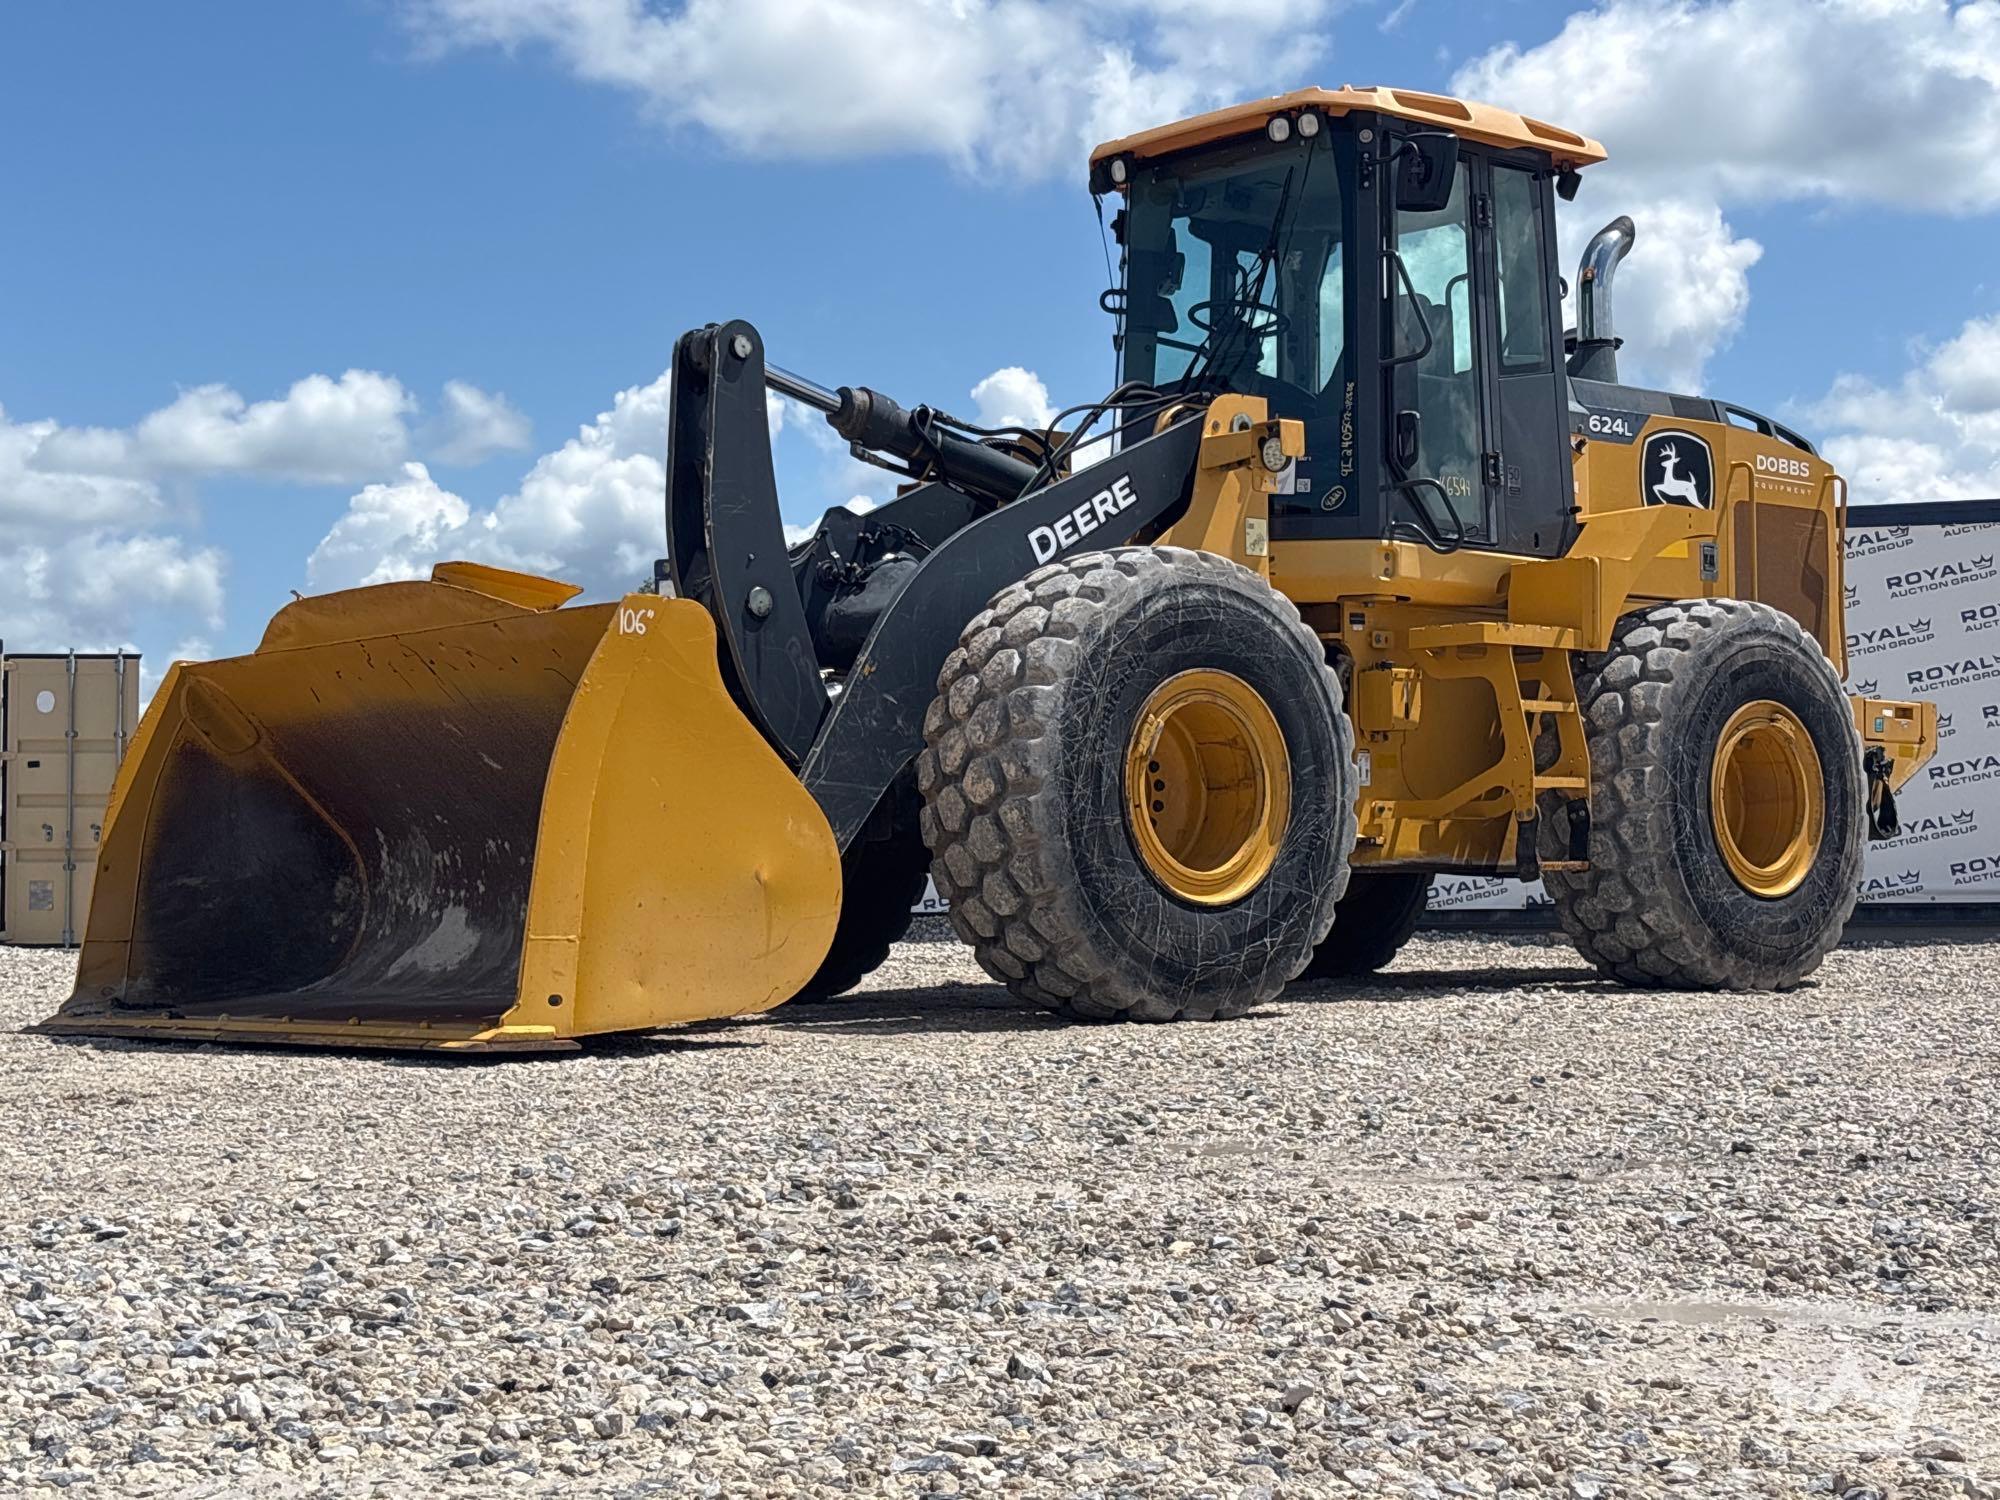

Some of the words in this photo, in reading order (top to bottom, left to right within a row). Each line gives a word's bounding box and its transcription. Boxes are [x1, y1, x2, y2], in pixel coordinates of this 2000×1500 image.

[1588, 414, 1633, 437] 624L
[1756, 454, 1810, 477] DOBBS
[1753, 481, 1812, 495] EQUIPMENT
[1026, 474, 1138, 566] DEERE
[1867, 538, 1914, 554] GROUP
[1885, 561, 1973, 590] ROYAL
[1890, 580, 1949, 600] AUCTION
[1951, 569, 1998, 586] GROUP
[619, 607, 655, 635] 106"
[1888, 633, 1936, 649] GROUP
[1907, 657, 1994, 685] ROYAL
[1911, 675, 1970, 695] AUCTION
[1932, 771, 1992, 790] AUCTION
[1870, 833, 1929, 852] AUCTION
[1931, 824, 1979, 840] GROUP
[1465, 887, 1509, 902] GROUP
[1877, 885, 1924, 899] GROUP
